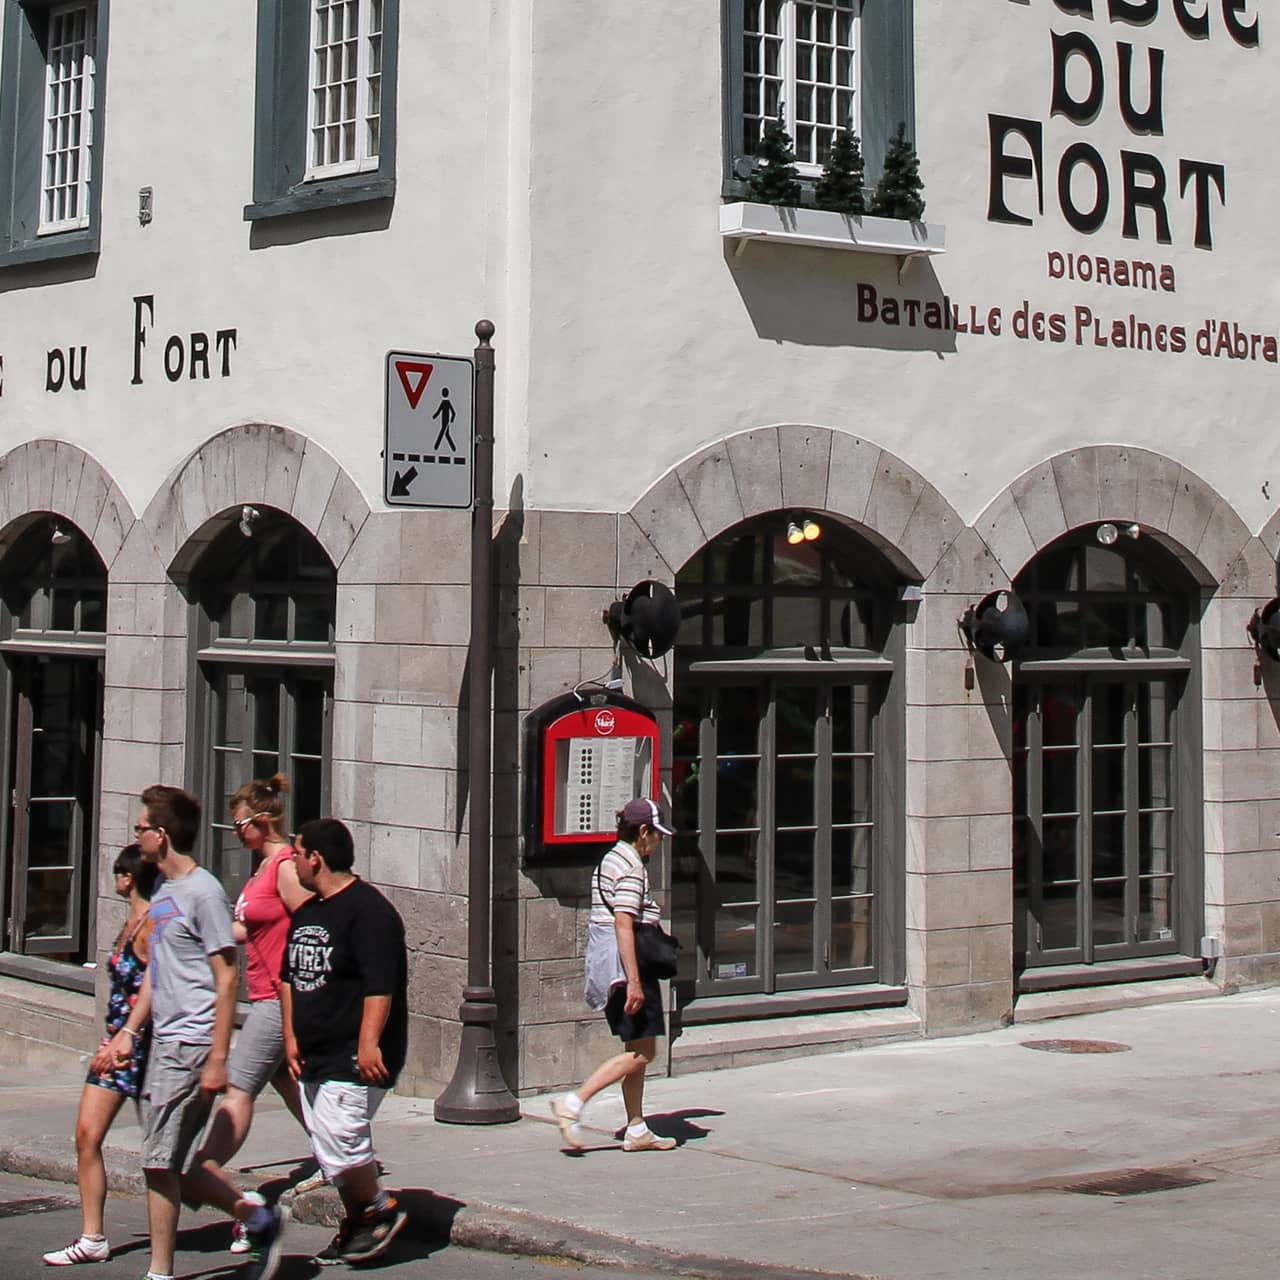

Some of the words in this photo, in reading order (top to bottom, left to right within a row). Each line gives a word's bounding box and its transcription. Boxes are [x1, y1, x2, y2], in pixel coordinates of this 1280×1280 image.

[1050, 28, 1165, 136] DU
[987, 113, 1225, 251] FORT
[1012, 300, 1066, 342] des
[1074, 305, 1186, 353] Plaines
